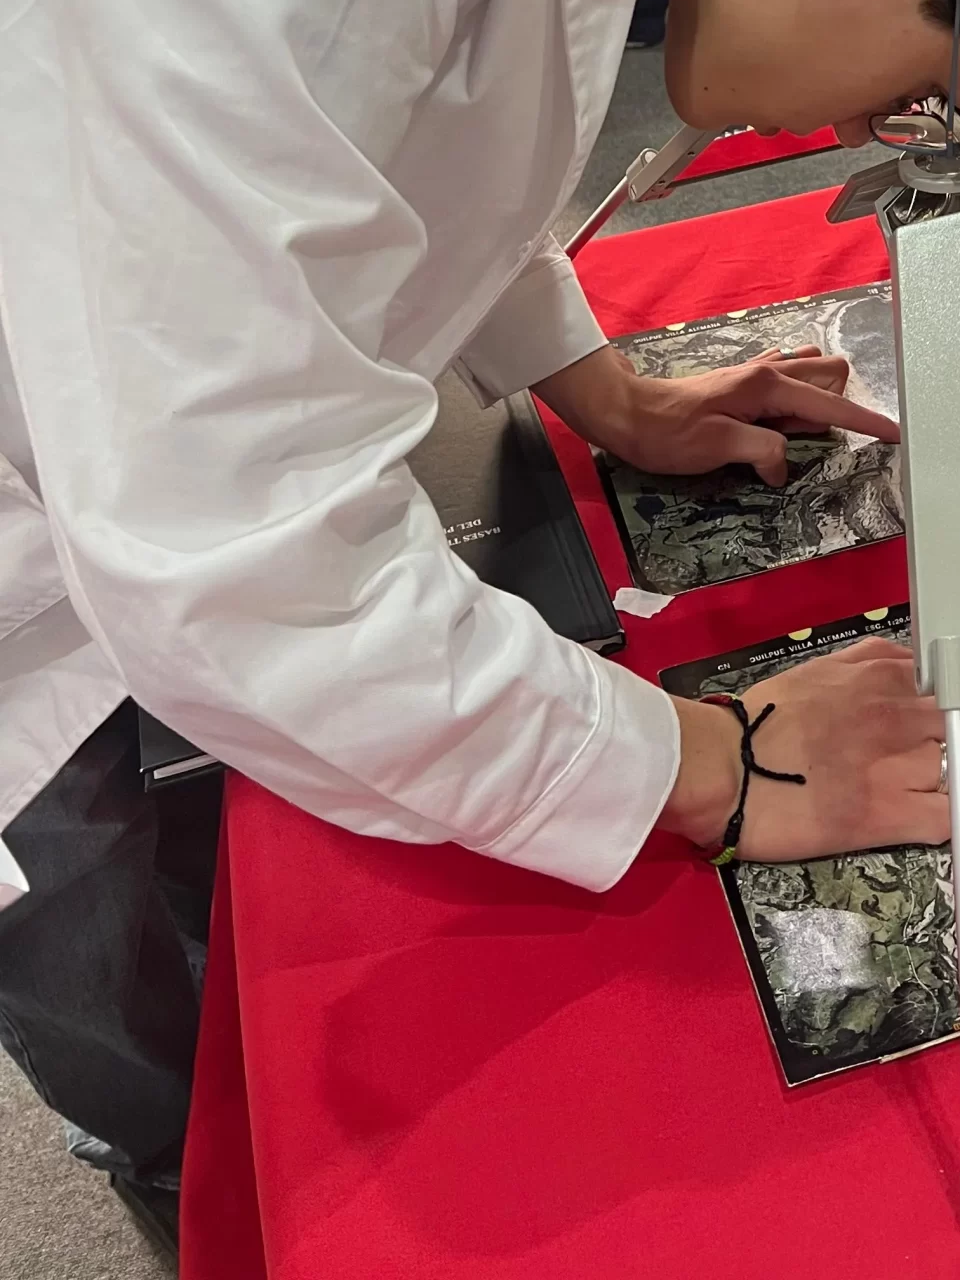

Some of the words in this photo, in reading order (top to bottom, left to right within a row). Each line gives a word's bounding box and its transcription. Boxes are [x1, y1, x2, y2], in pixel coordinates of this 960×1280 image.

[665, 329, 685, 337] VILLA
[688, 322, 721, 332] ALEMANA
[455, 518, 482, 530] DEL
[462, 526, 501, 542] BASES
[788, 640, 813, 652] VILLA
[816, 628, 858, 644] ALEMANA
[864, 621, 885, 632] ESC.
